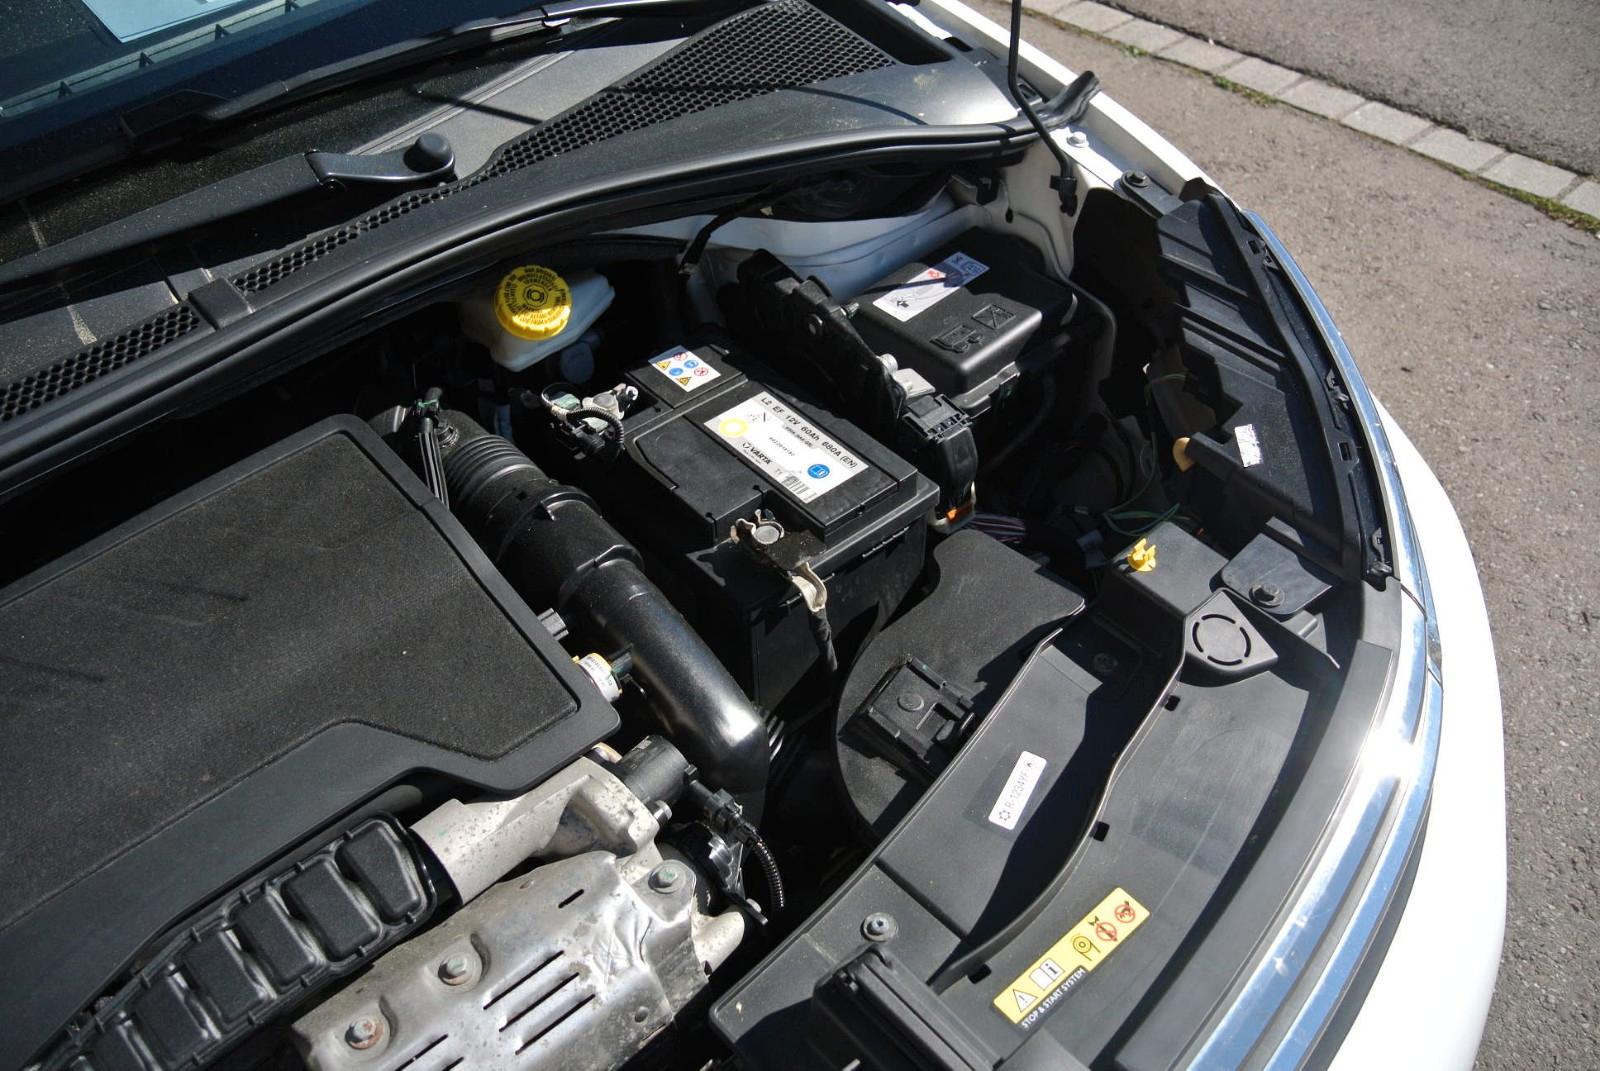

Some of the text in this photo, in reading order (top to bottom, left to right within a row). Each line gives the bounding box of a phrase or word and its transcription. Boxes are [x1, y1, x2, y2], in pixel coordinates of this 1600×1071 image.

[750, 446, 772, 465] VARTA
[761, 397, 772, 406] L2
[772, 405, 784, 414] EF
[785, 414, 800, 426] 12V
[801, 426, 820, 442] 60Ah
[822, 441, 841, 457] 680A
[841, 455, 858, 468] (EN)
[1021, 1011, 1039, 1028] STOP
[1043, 989, 1064, 1009] START
[1062, 967, 1087, 992] SYSTEM
